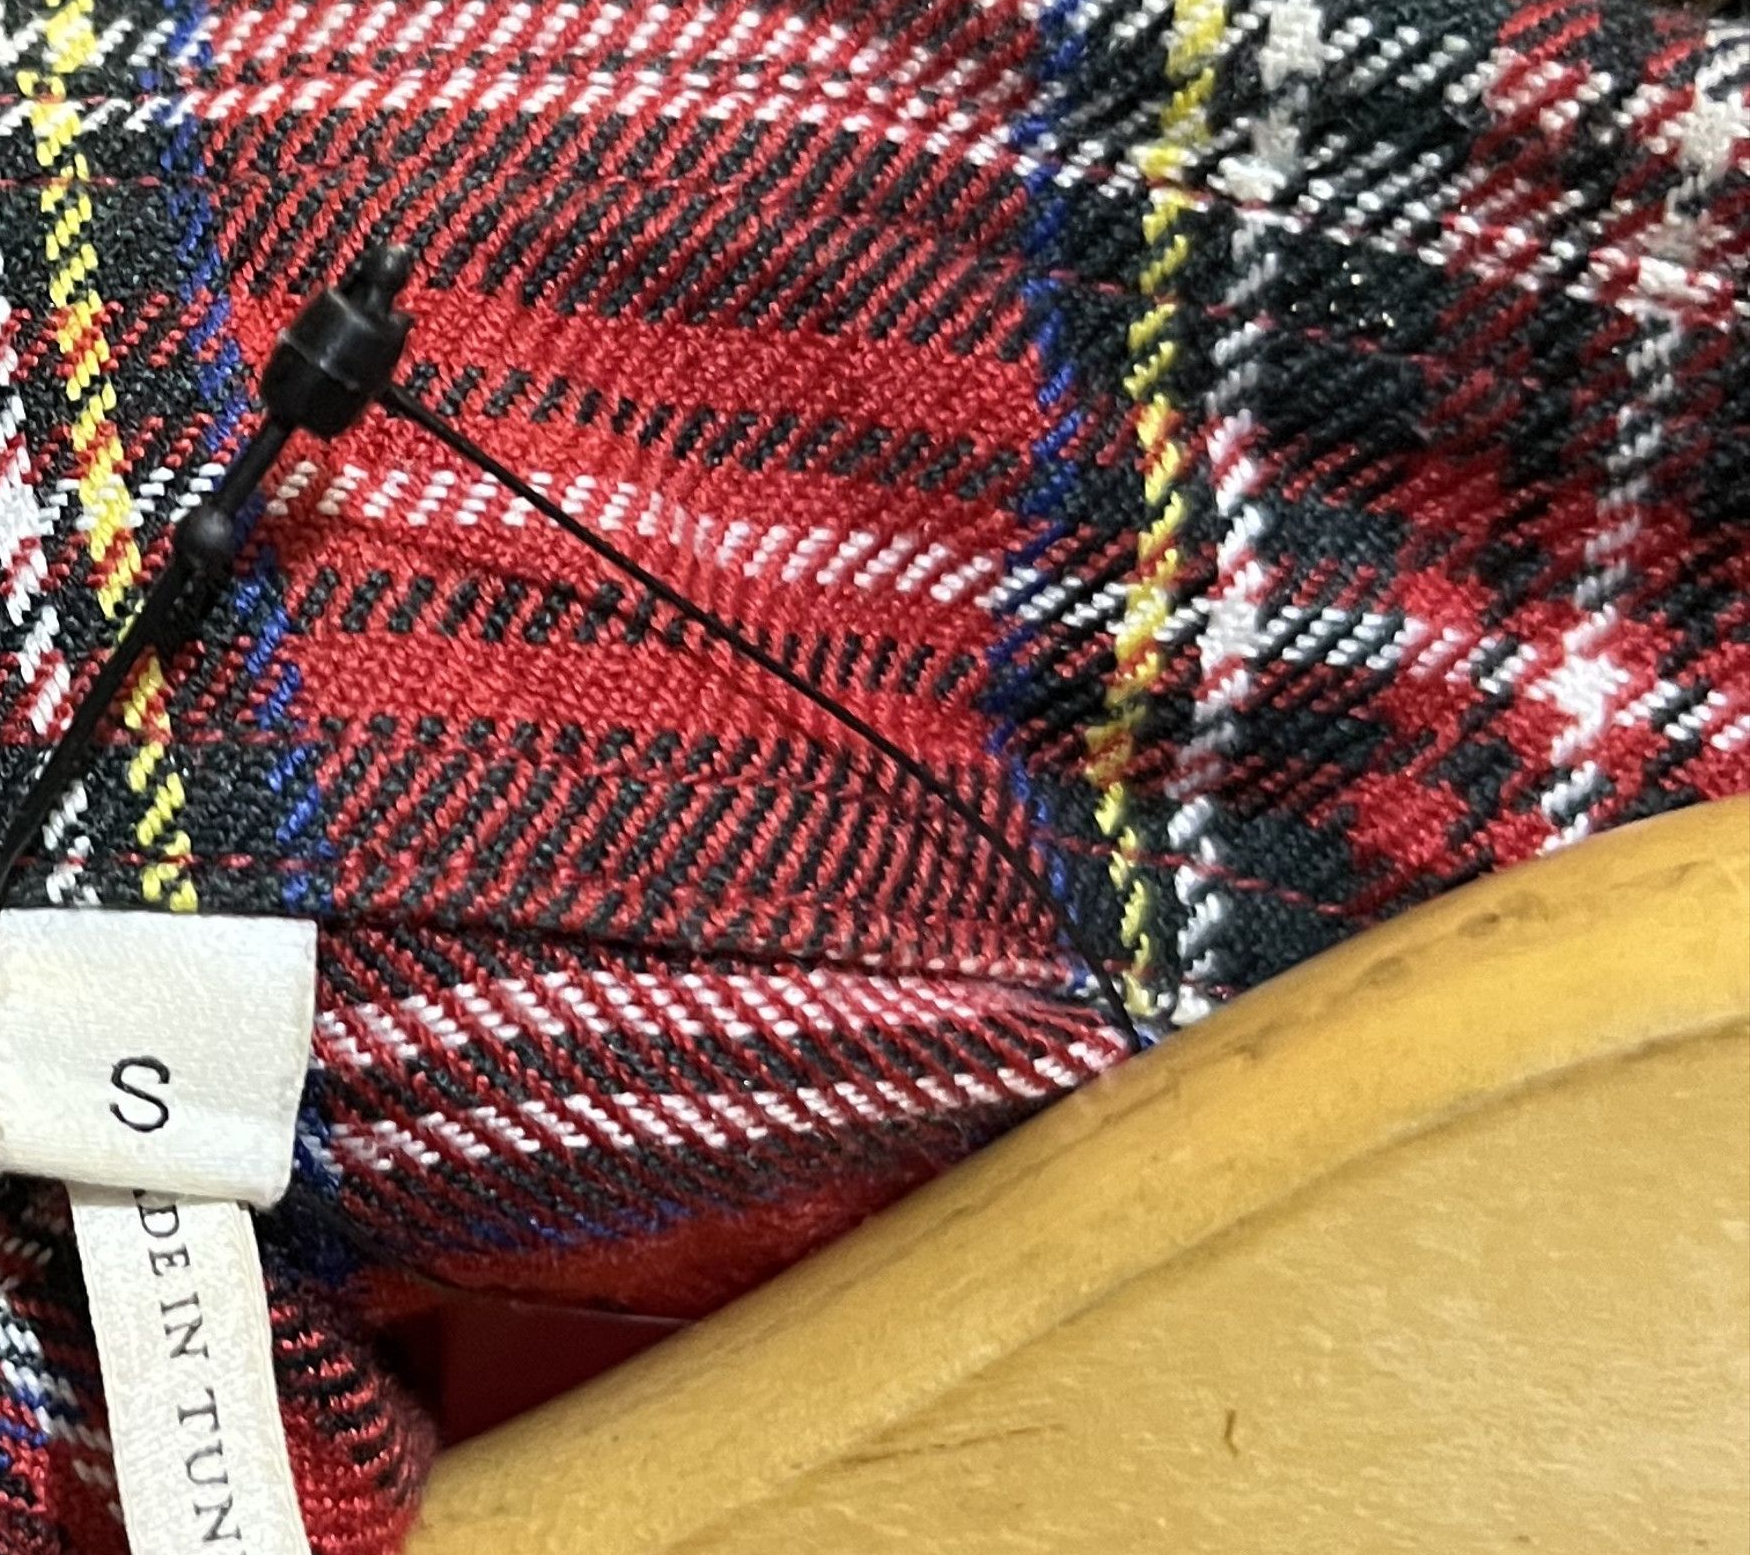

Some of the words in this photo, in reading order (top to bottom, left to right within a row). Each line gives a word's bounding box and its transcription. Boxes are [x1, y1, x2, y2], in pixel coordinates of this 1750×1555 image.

[107, 1054, 172, 1134] S
[133, 1188, 191, 1277] DE
[159, 1291, 210, 1360] IN
